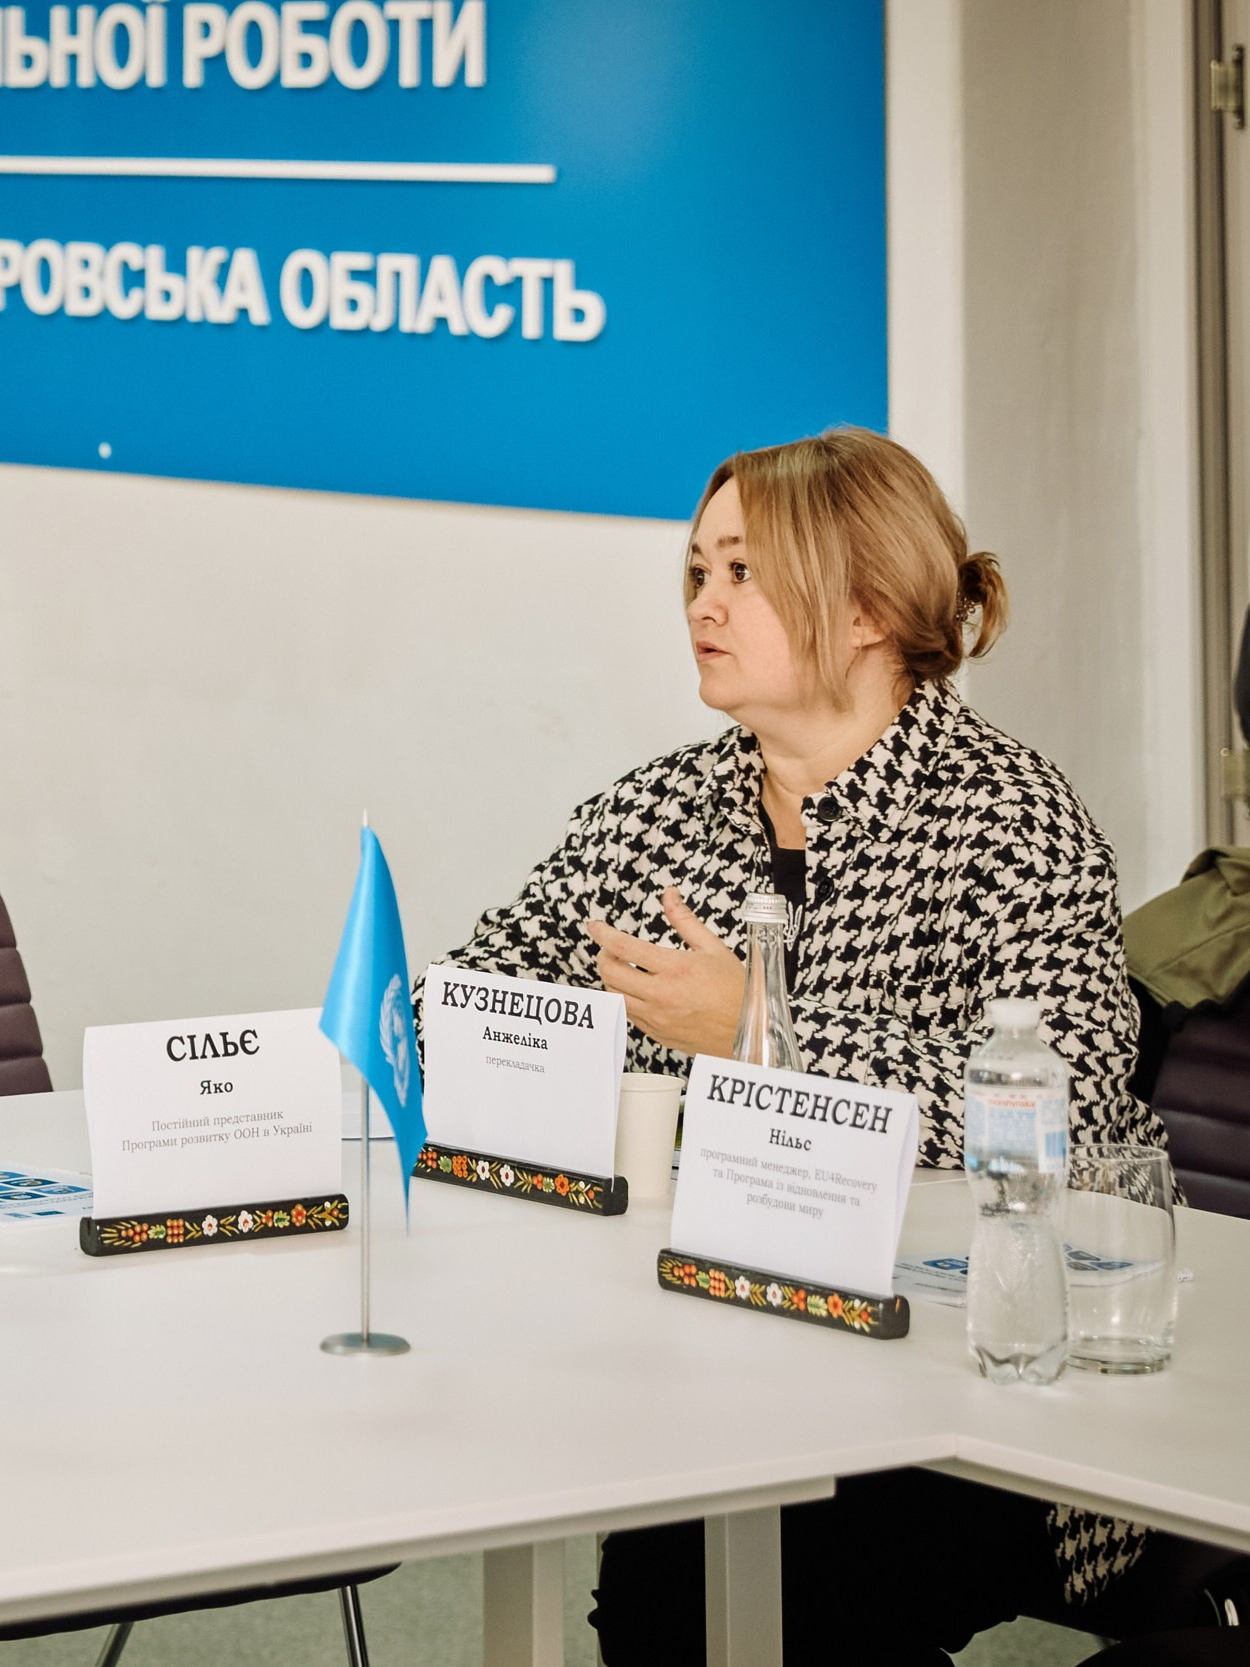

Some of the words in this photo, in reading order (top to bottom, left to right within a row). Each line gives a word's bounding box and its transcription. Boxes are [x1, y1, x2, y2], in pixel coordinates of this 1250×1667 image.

[183, 1, 487, 91] РОБОТИ
[280, 250, 606, 342] ОБЛАСТЬ
[441, 981, 595, 1030] КУЗНЕЦОВА
[166, 1029, 260, 1062] СІЛЬЄ
[482, 1026, 548, 1050] Анжеліка
[486, 1055, 545, 1074] перекладачка
[199, 1080, 234, 1096] Яко
[707, 1074, 893, 1134] КРІСТЕНСЕН
[151, 1116, 211, 1132] Постійний
[213, 1110, 284, 1129] представник
[122, 1136, 178, 1153] Програми
[180, 1132, 231, 1148] розвитку
[233, 1126, 260, 1139] ООН
[263, 1129, 270, 1137] в
[273, 1122, 313, 1137] Україні
[768, 1128, 812, 1151] Нільс
[700, 1148, 758, 1169] програмний
[814, 1167, 877, 1193] EU4Recovery
[713, 1168, 723, 1179] та
[726, 1168, 773, 1189] Програма
[786, 1182, 847, 1204] відновлення
[849, 1196, 861, 1207] та
[746, 1191, 795, 1212] розбудови
[798, 1204, 824, 1219] миру
